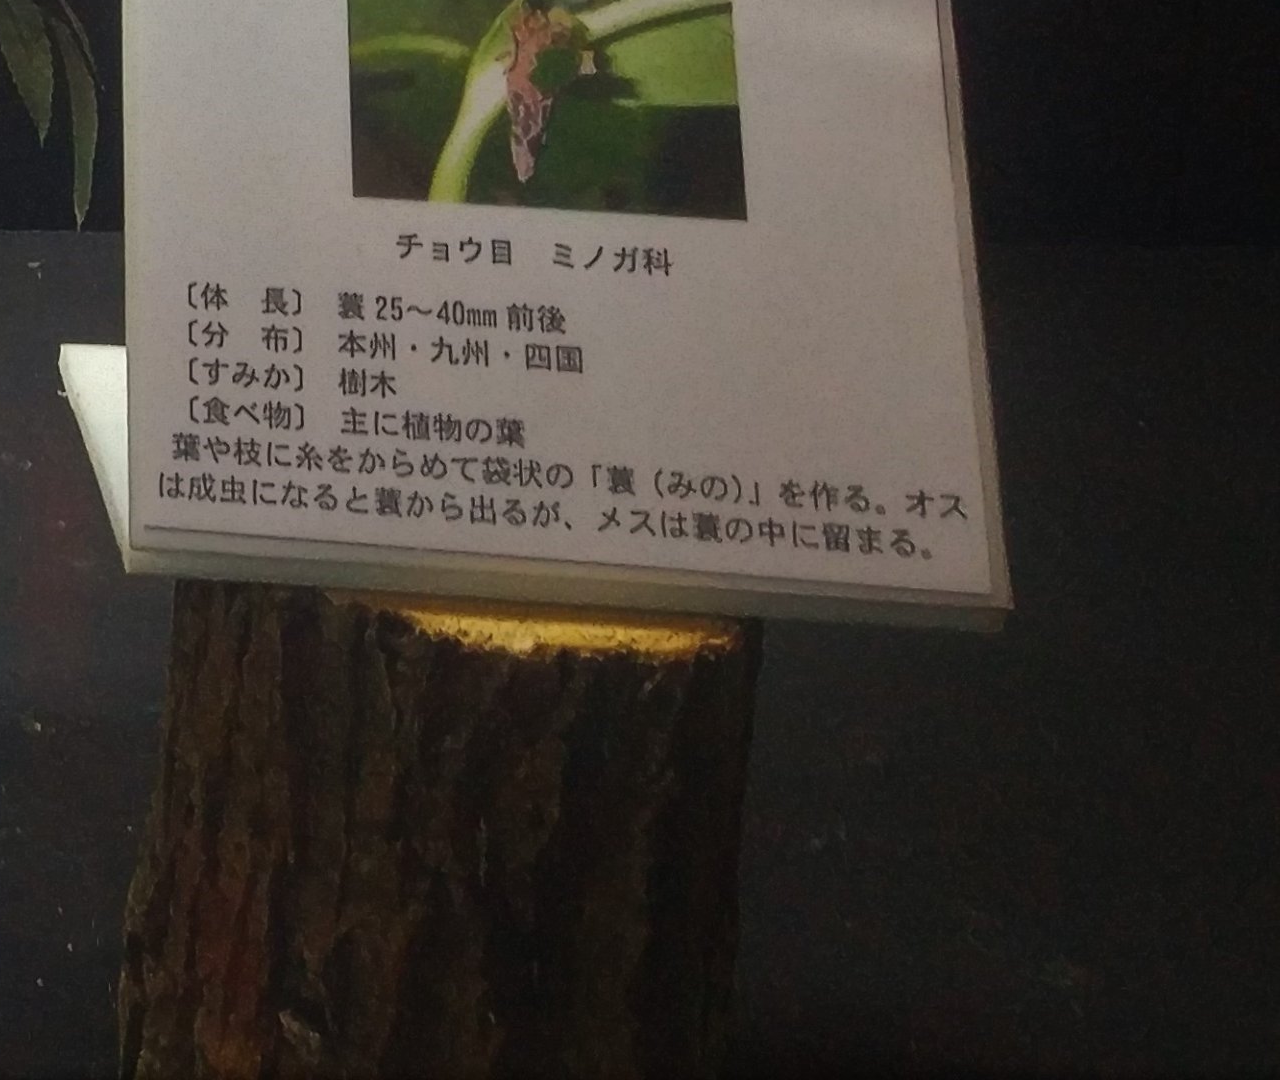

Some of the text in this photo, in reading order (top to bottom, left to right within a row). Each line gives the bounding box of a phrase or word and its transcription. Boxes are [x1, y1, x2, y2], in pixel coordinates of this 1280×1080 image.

[396, 234, 674, 276] チョウ目 ミノガ科
[339, 367, 397, 398] 樹木
